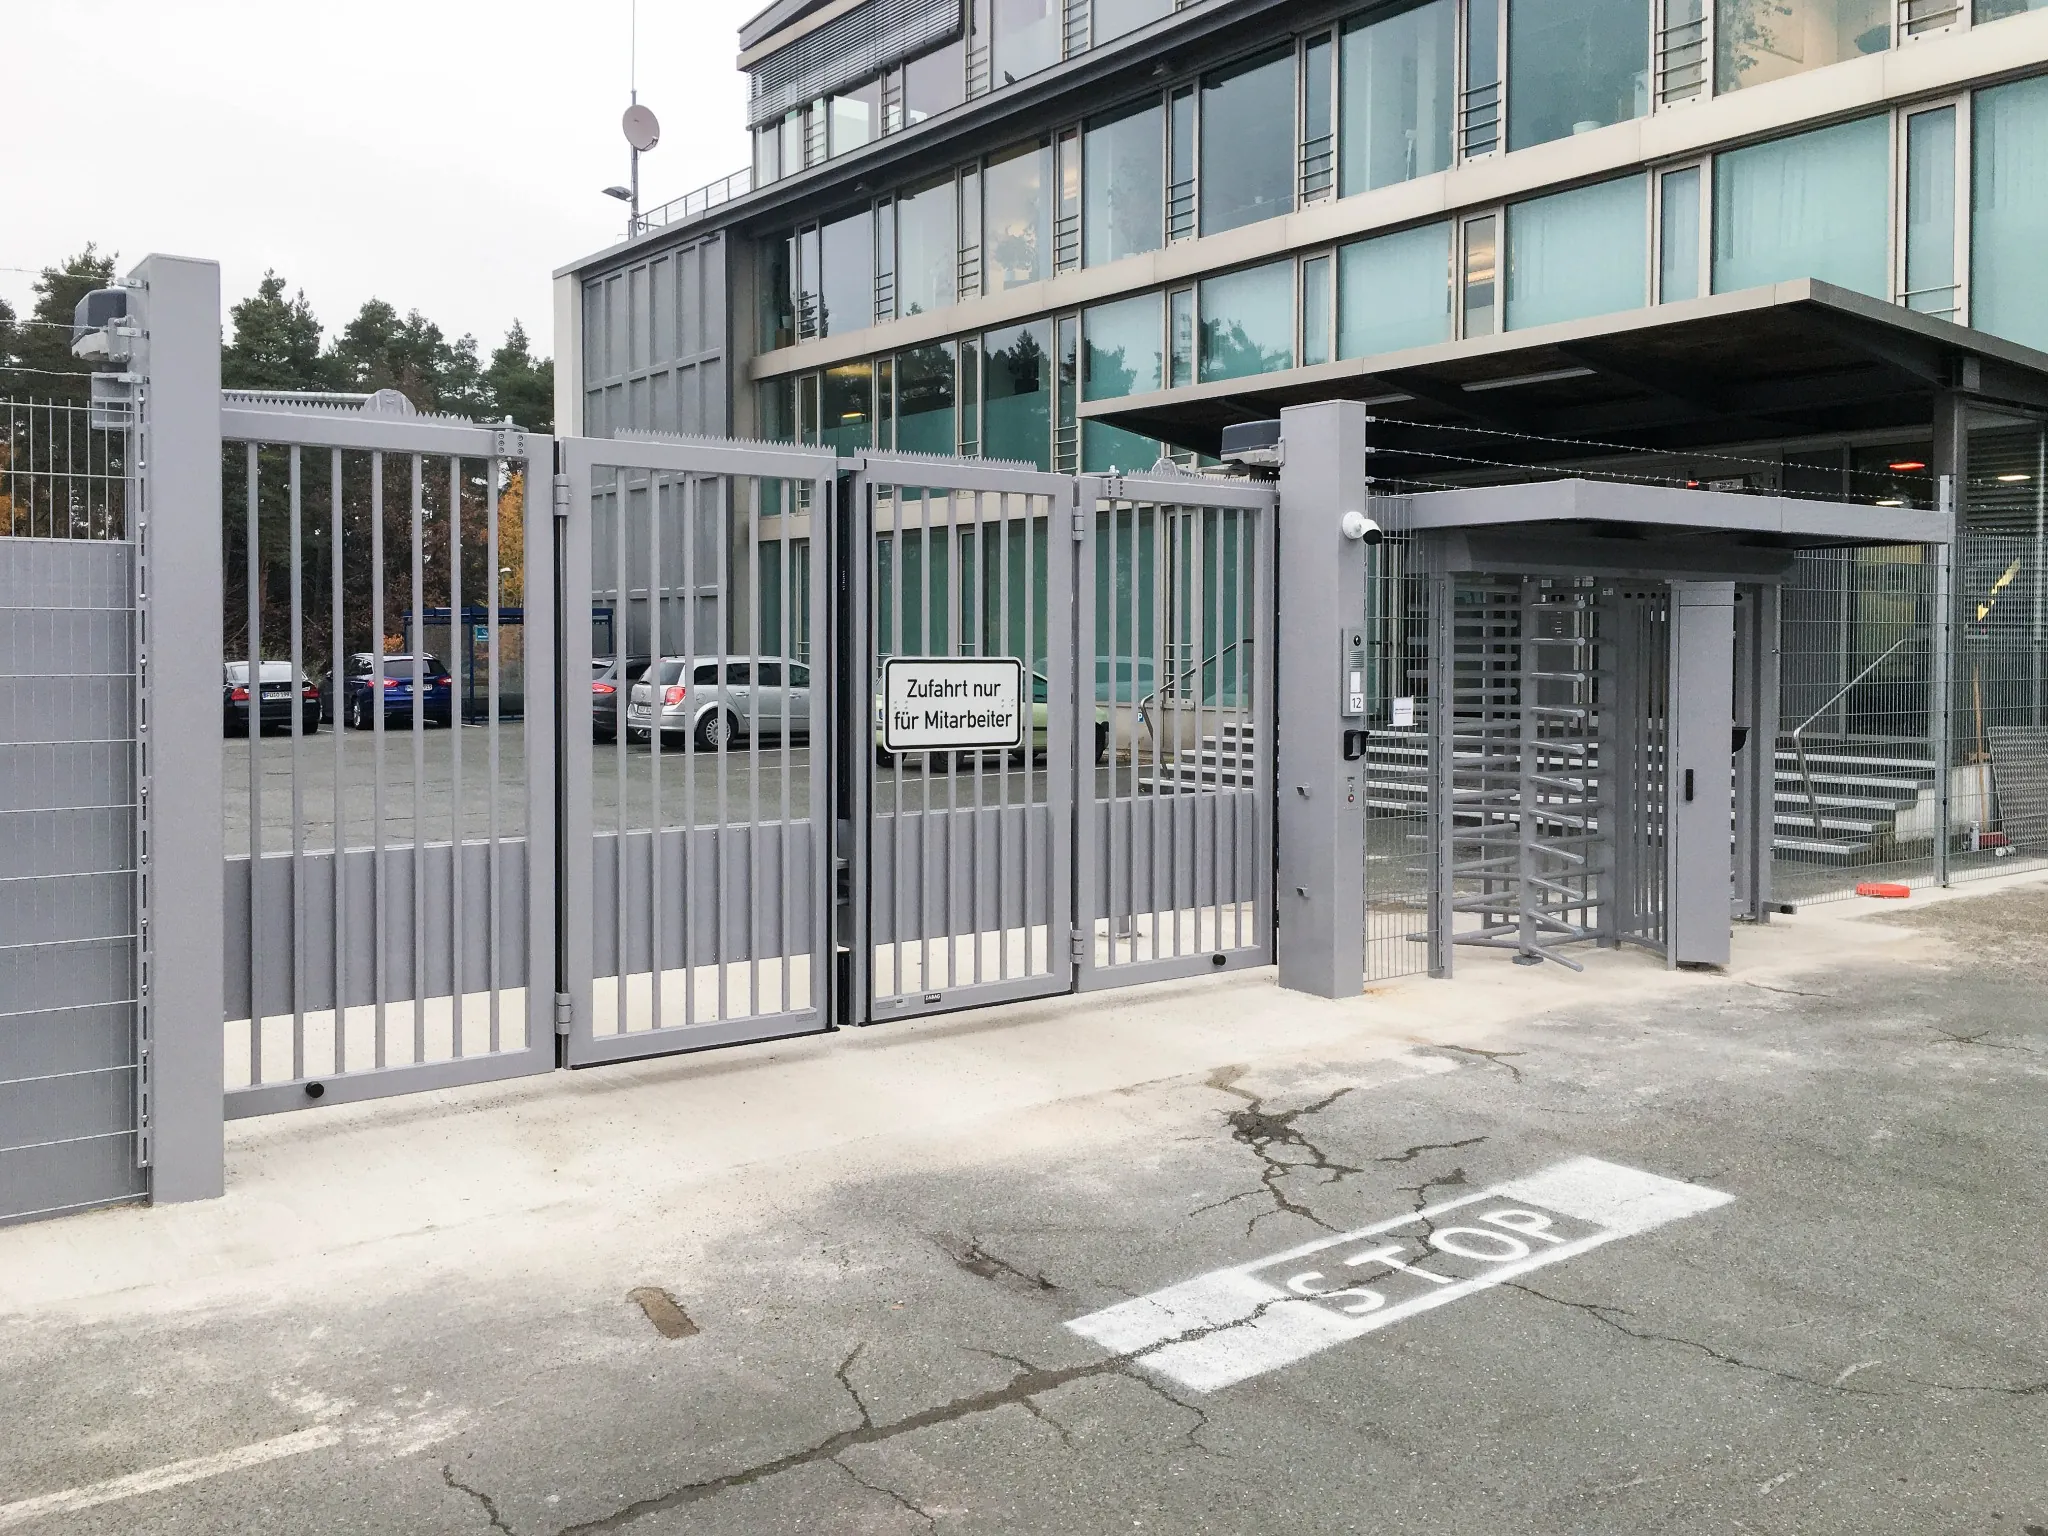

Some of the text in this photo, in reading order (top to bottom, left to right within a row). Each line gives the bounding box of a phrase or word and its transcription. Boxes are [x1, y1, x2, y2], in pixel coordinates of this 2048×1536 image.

[907, 679, 1001, 698] Zufahrt nur
[1352, 697, 1361, 708] 12
[894, 709, 1012, 730] für Mitarbeiter
[1287, 1209, 1566, 1313] STOP
